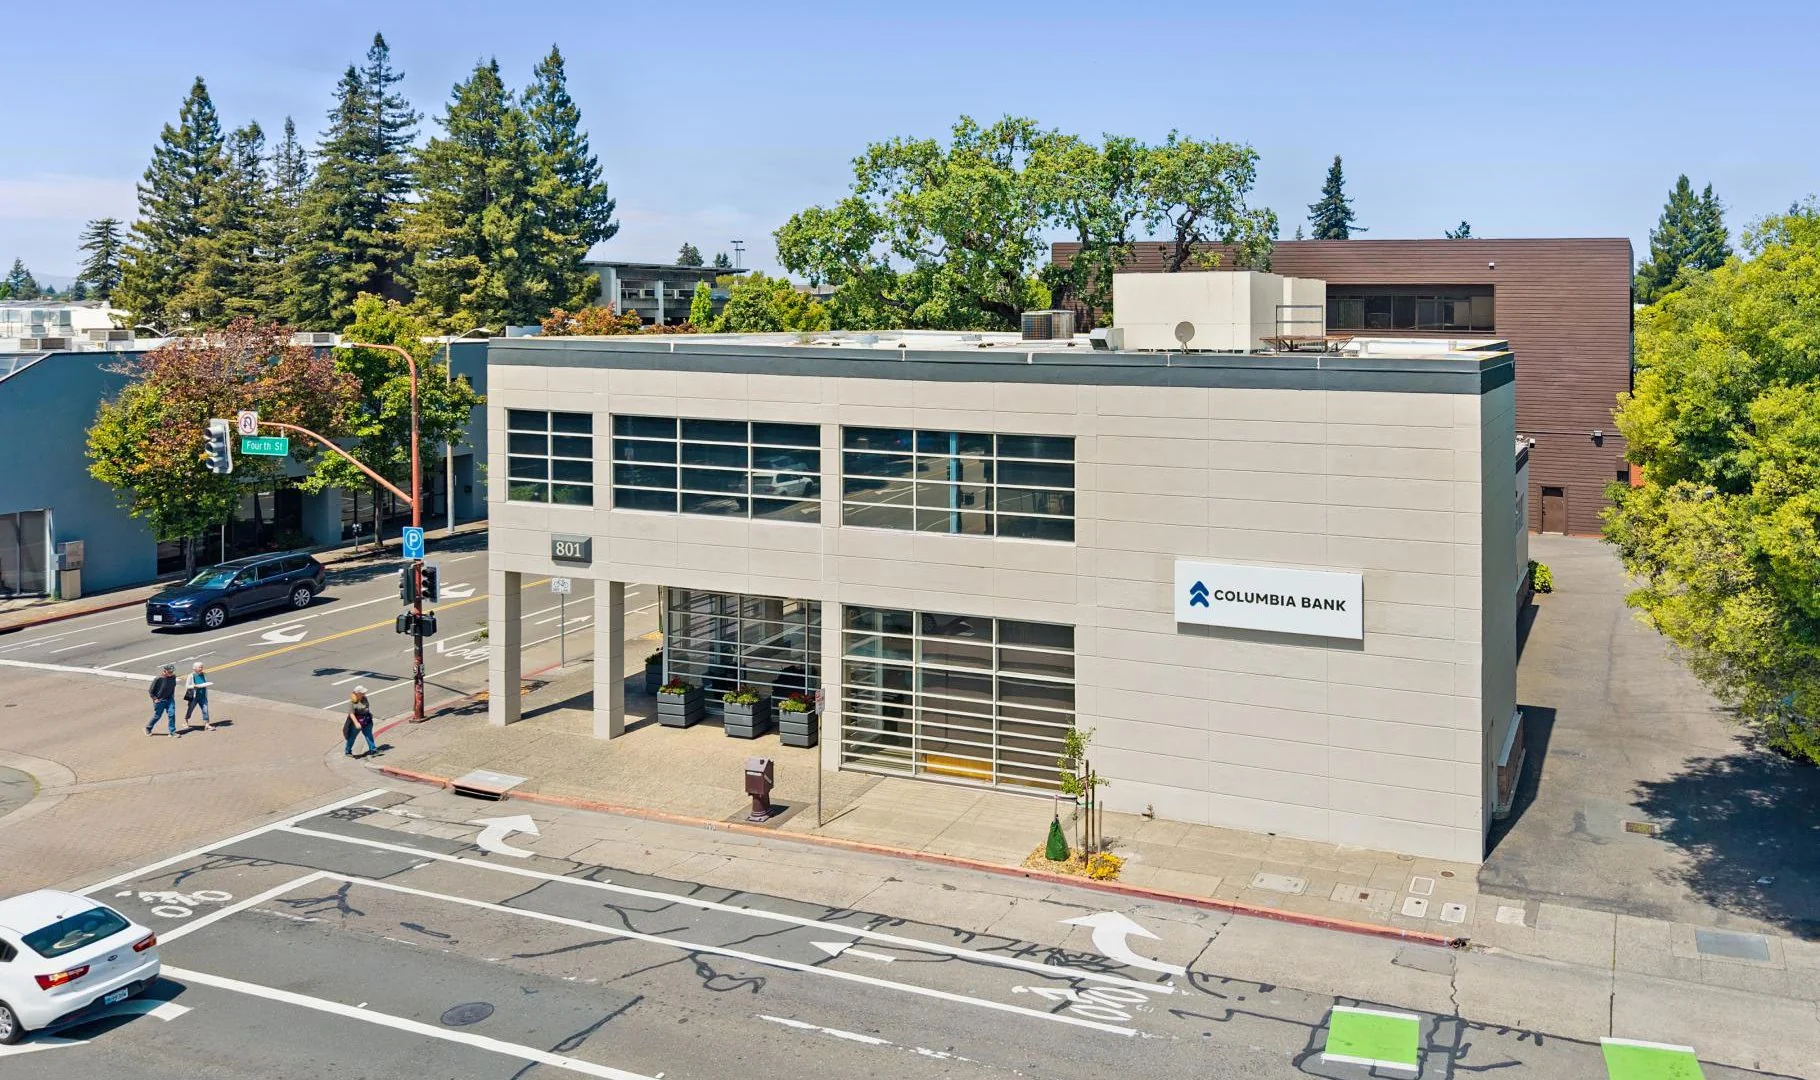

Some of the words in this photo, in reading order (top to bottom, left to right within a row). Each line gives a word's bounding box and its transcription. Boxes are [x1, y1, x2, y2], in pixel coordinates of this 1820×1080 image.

[246, 440, 272, 450] Fourth
[274, 441, 283, 451] St
[409, 532, 419, 547] P
[556, 541, 581, 557] 801
[1214, 589, 1297, 608] COLUMBIA
[1301, 597, 1346, 612] BANK
